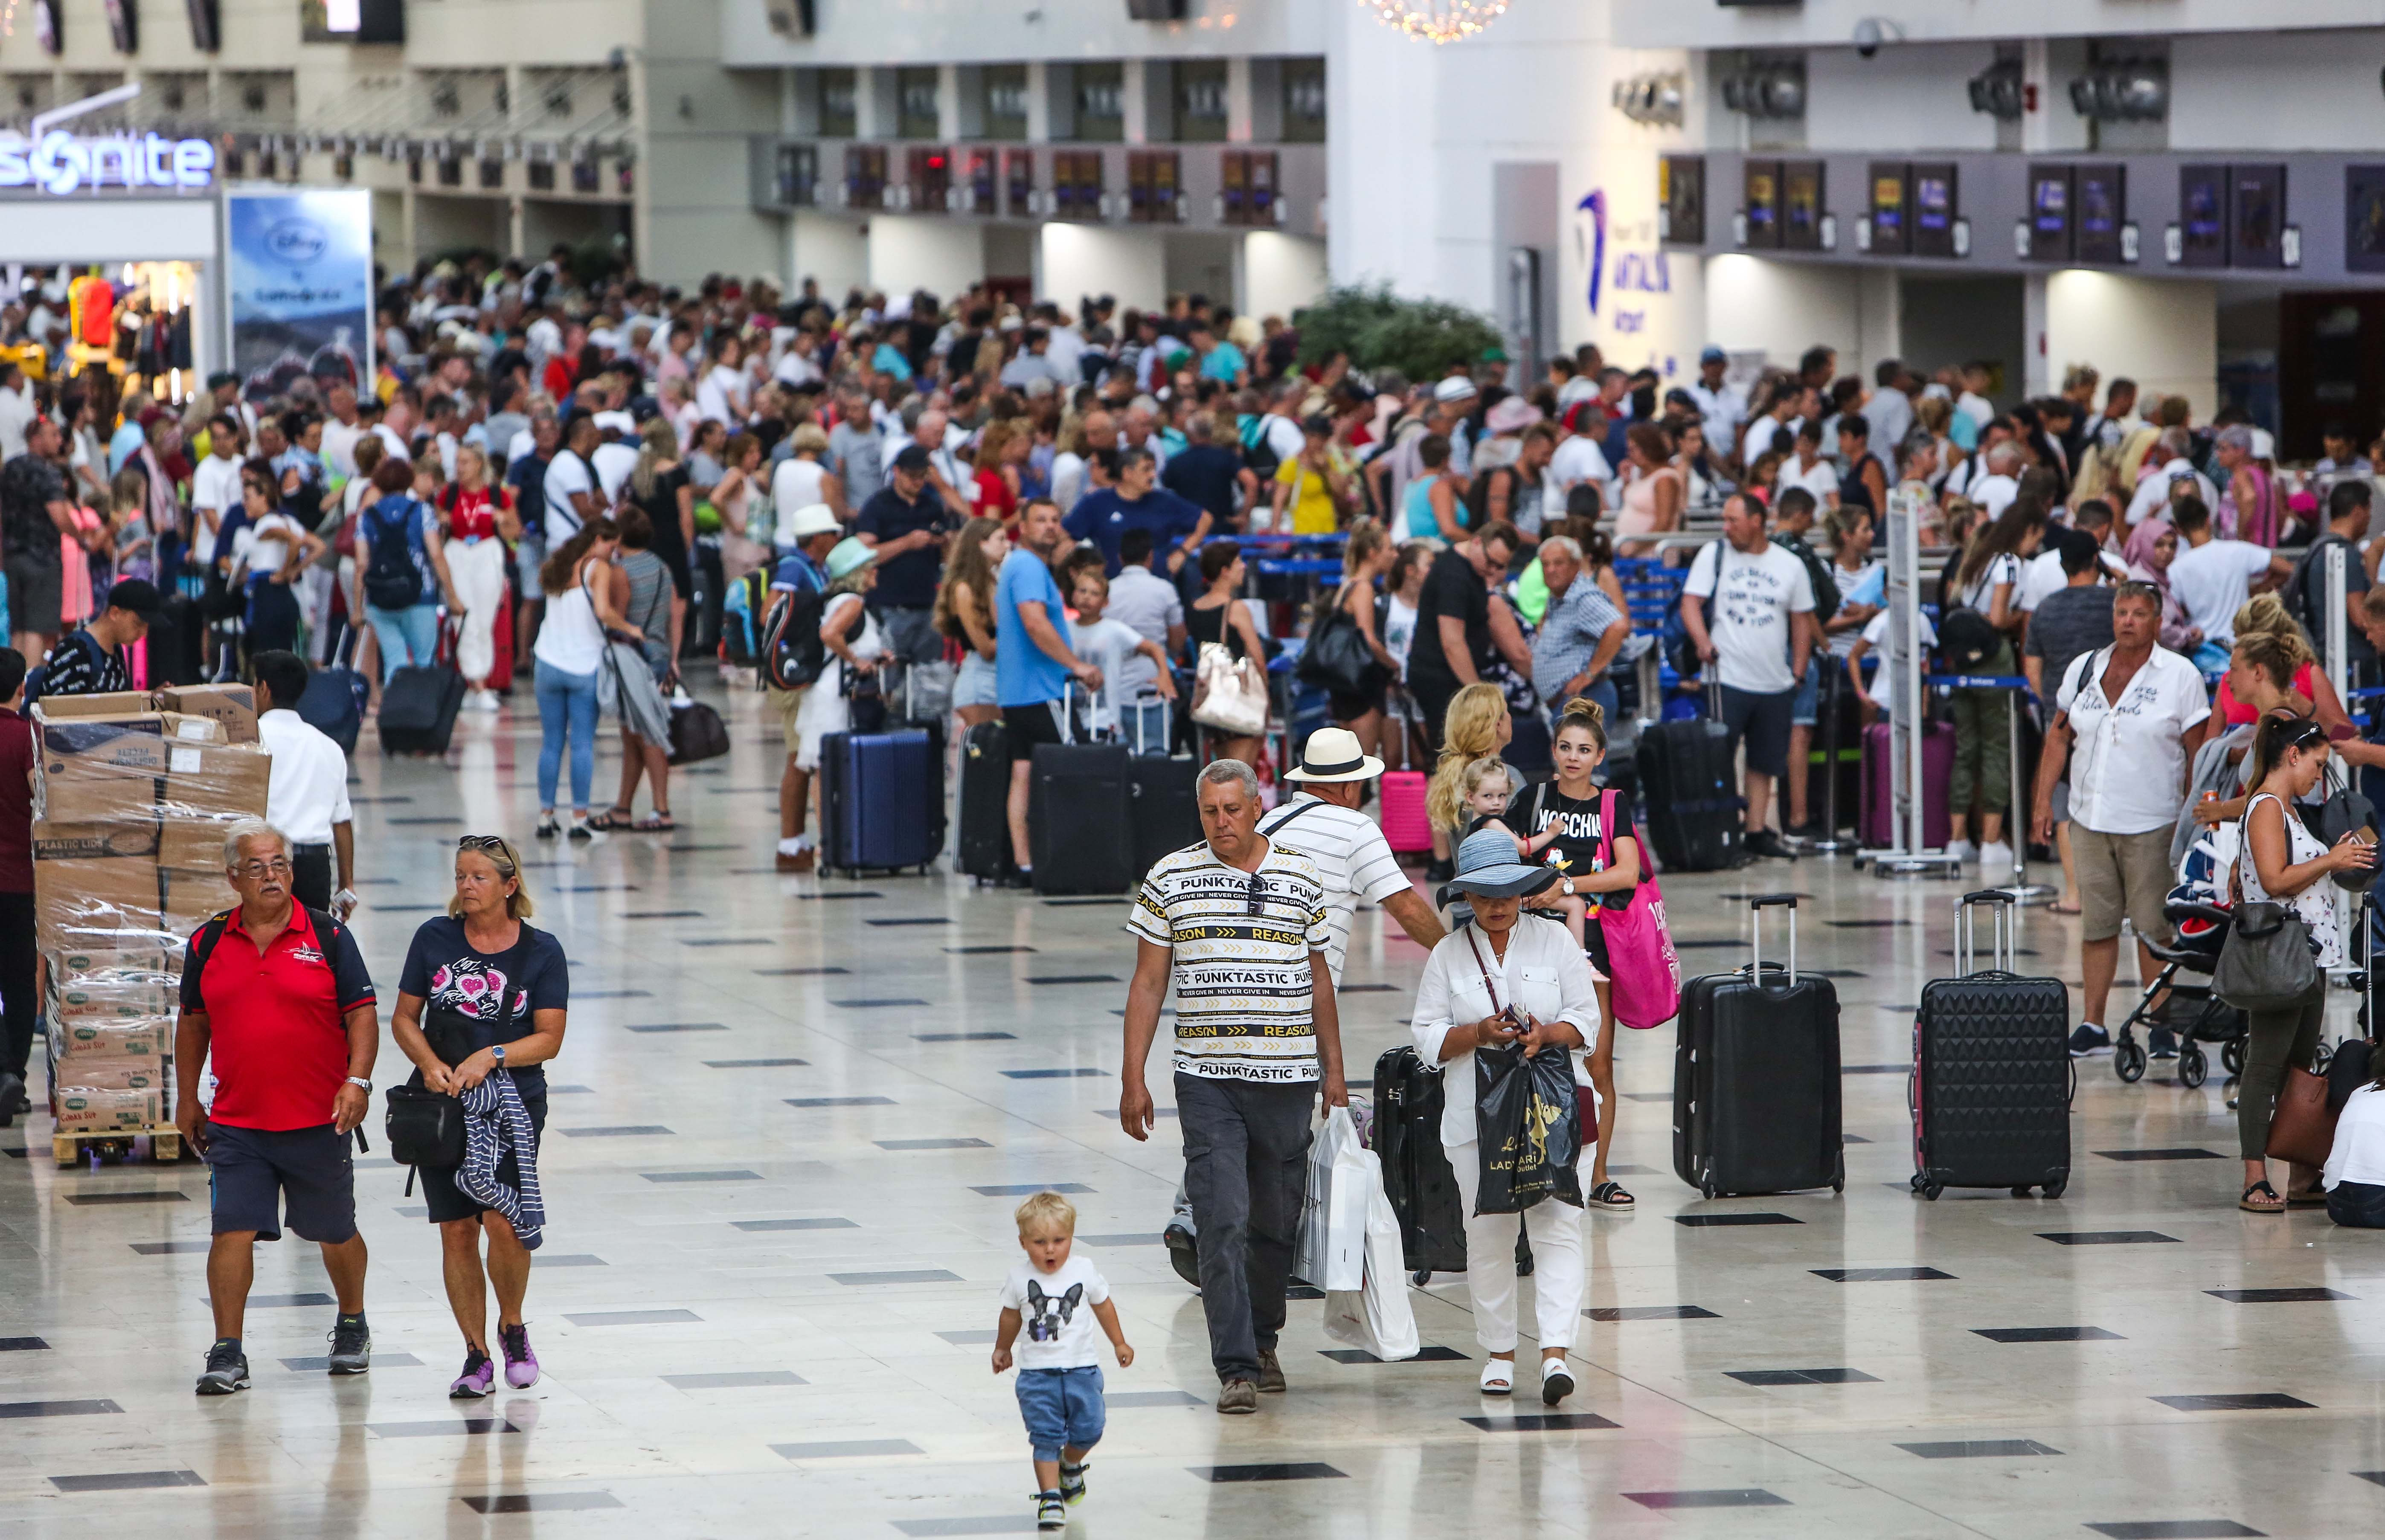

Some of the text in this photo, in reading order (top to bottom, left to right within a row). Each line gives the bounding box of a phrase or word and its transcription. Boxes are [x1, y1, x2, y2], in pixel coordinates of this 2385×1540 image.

[38, 839, 78, 850] PLASTIC
[1267, 896, 1288, 905] NEVER
[1252, 928, 1303, 944] REASON
[452, 957, 481, 972] COOL
[1195, 972, 1288, 984] PUNKTASTIC
[1179, 1025, 1310, 1037] REASON REASON
[1199, 1065, 1293, 1079] PUNKTASTIC
[1516, 1163, 1537, 1173] Outlet
